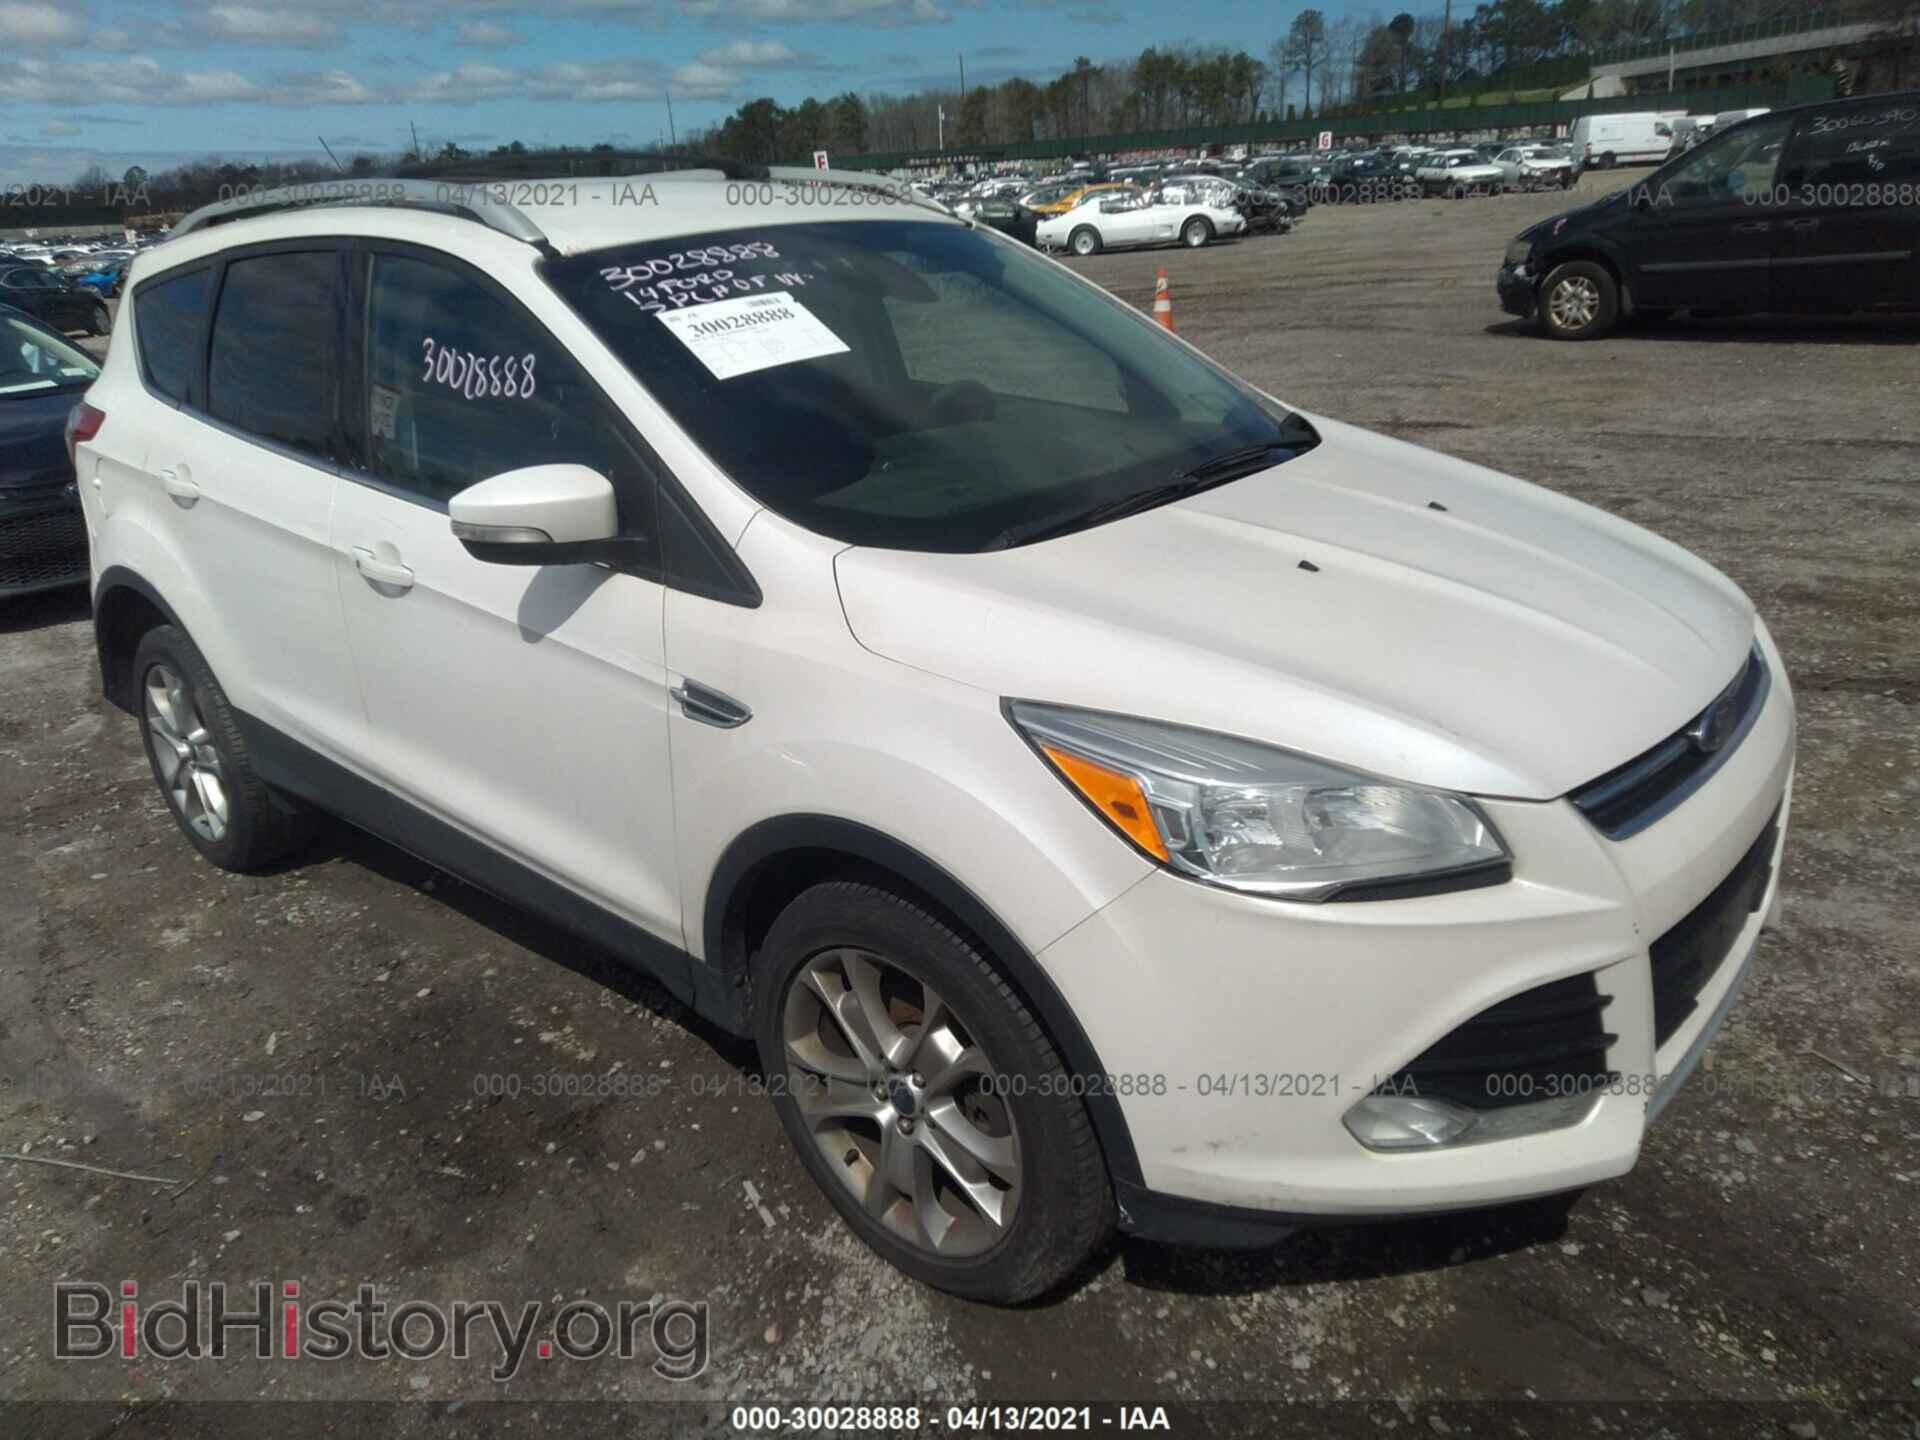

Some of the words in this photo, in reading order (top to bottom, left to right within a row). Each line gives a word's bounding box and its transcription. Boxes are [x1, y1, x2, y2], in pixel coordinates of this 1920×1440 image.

[817, 155, 826, 168] F
[600, 242, 780, 291] 30028888
[688, 307, 796, 338] 30028888
